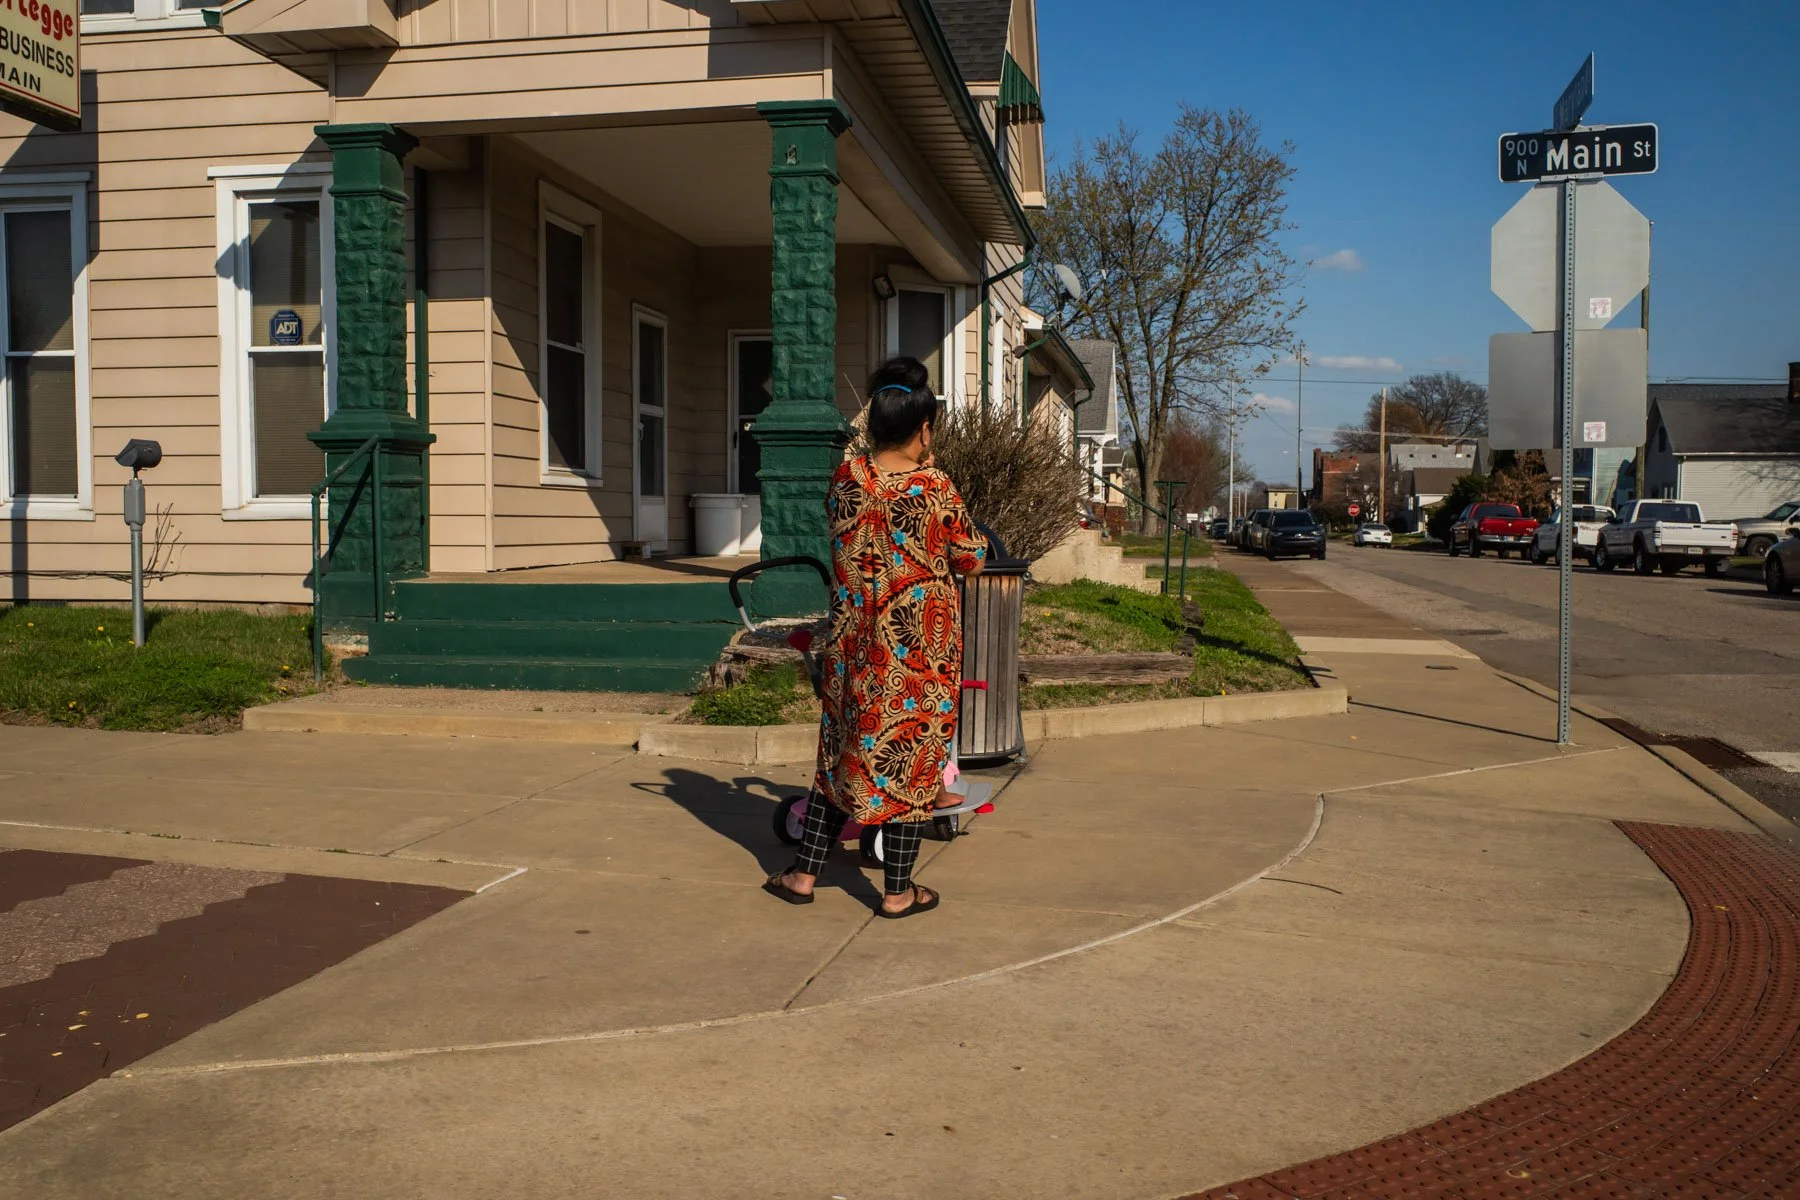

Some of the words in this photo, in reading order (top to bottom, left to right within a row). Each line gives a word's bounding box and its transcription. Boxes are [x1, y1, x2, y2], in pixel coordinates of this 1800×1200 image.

[0, 26, 75, 78] BUSINESS
[1505, 139, 1539, 157] 900
[1546, 136, 1622, 171] Main
[1633, 140, 1651, 158] St
[1517, 159, 1527, 176] N
[275, 321, 298, 335] ADT
